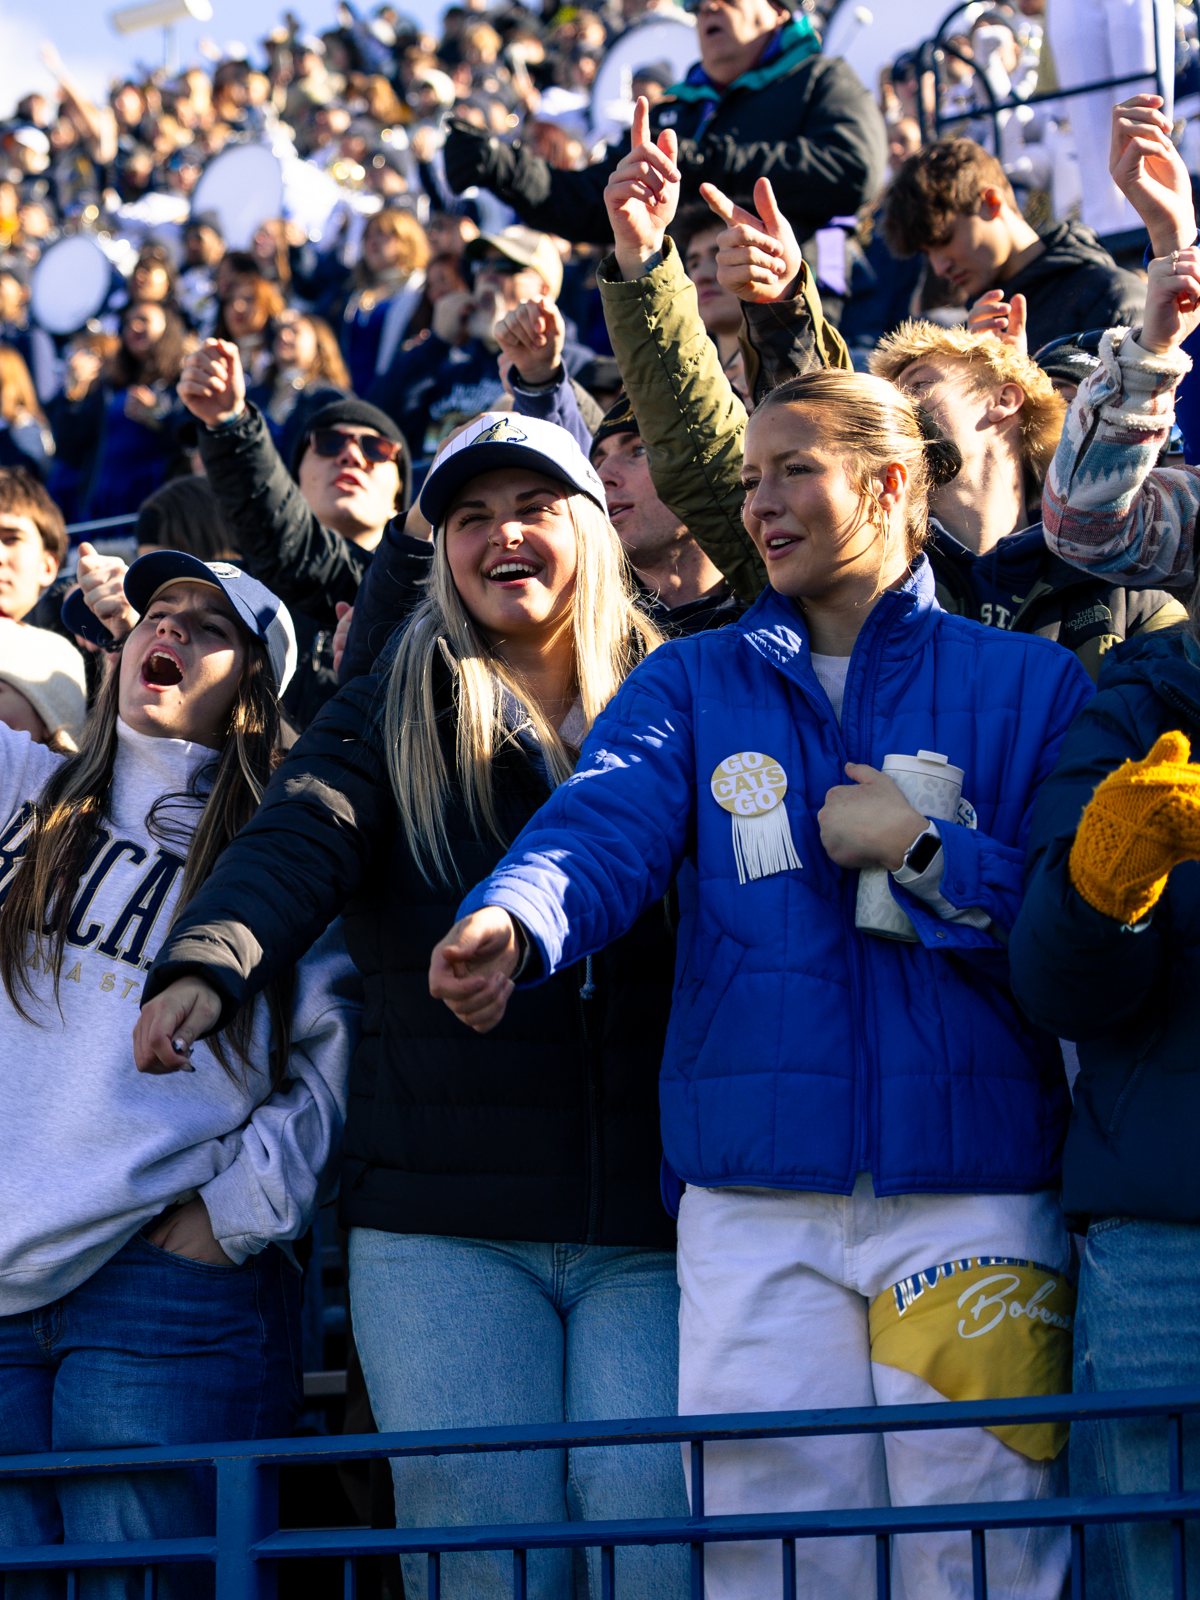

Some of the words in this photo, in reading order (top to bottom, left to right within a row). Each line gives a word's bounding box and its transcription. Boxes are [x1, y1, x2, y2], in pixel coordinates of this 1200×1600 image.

[721, 752, 764, 774] GO
[713, 766, 785, 798] CATS
[734, 789, 777, 815] GO
